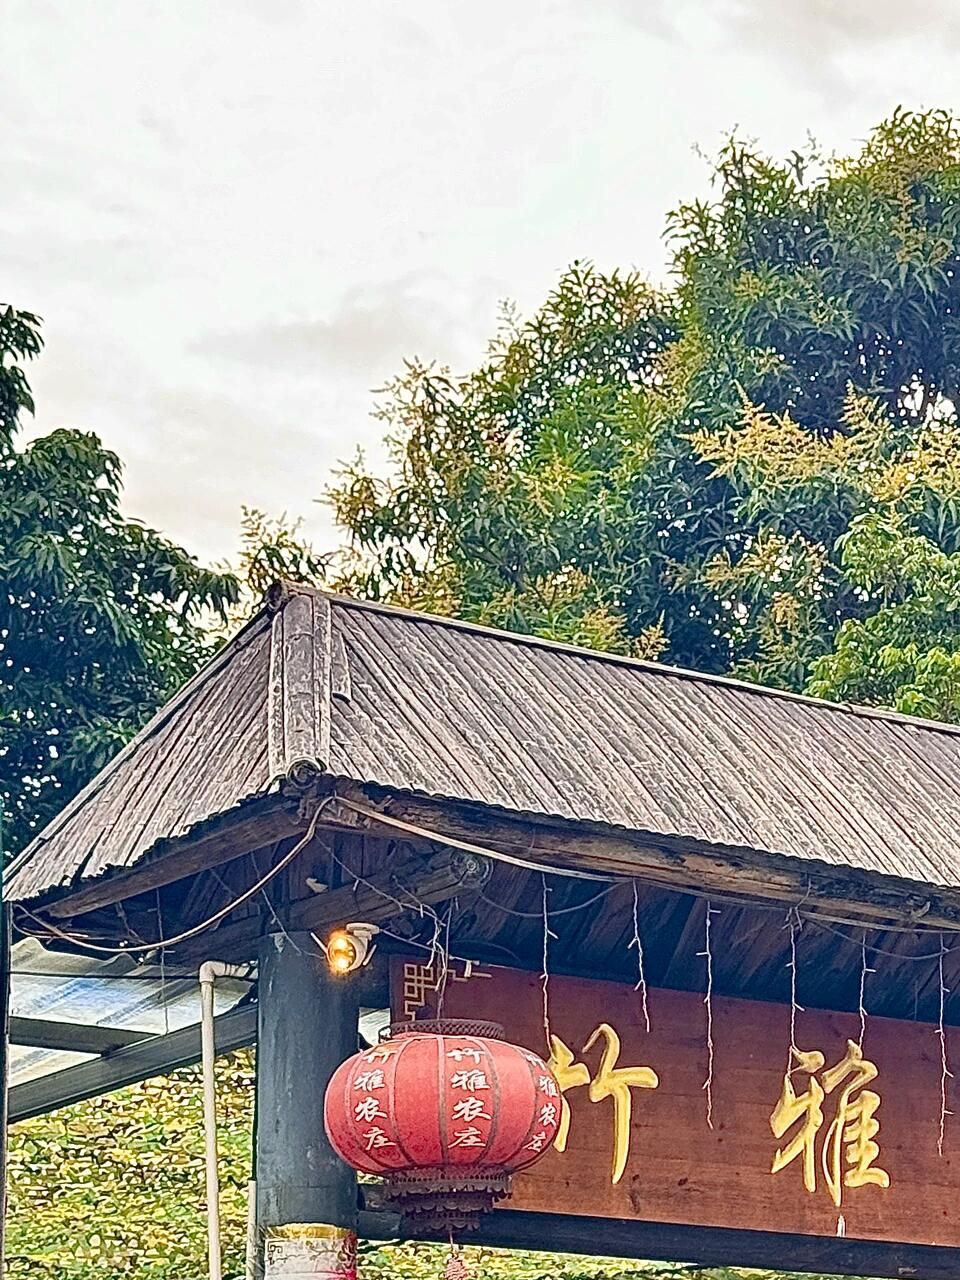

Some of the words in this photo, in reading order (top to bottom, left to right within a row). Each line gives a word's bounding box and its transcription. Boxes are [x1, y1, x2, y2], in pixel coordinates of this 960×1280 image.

[354, 1049, 398, 1150] 竹雅农庄
[447, 1047, 492, 1148] 竹雅农庄
[523, 1054, 559, 1152] 竹雅农庄
